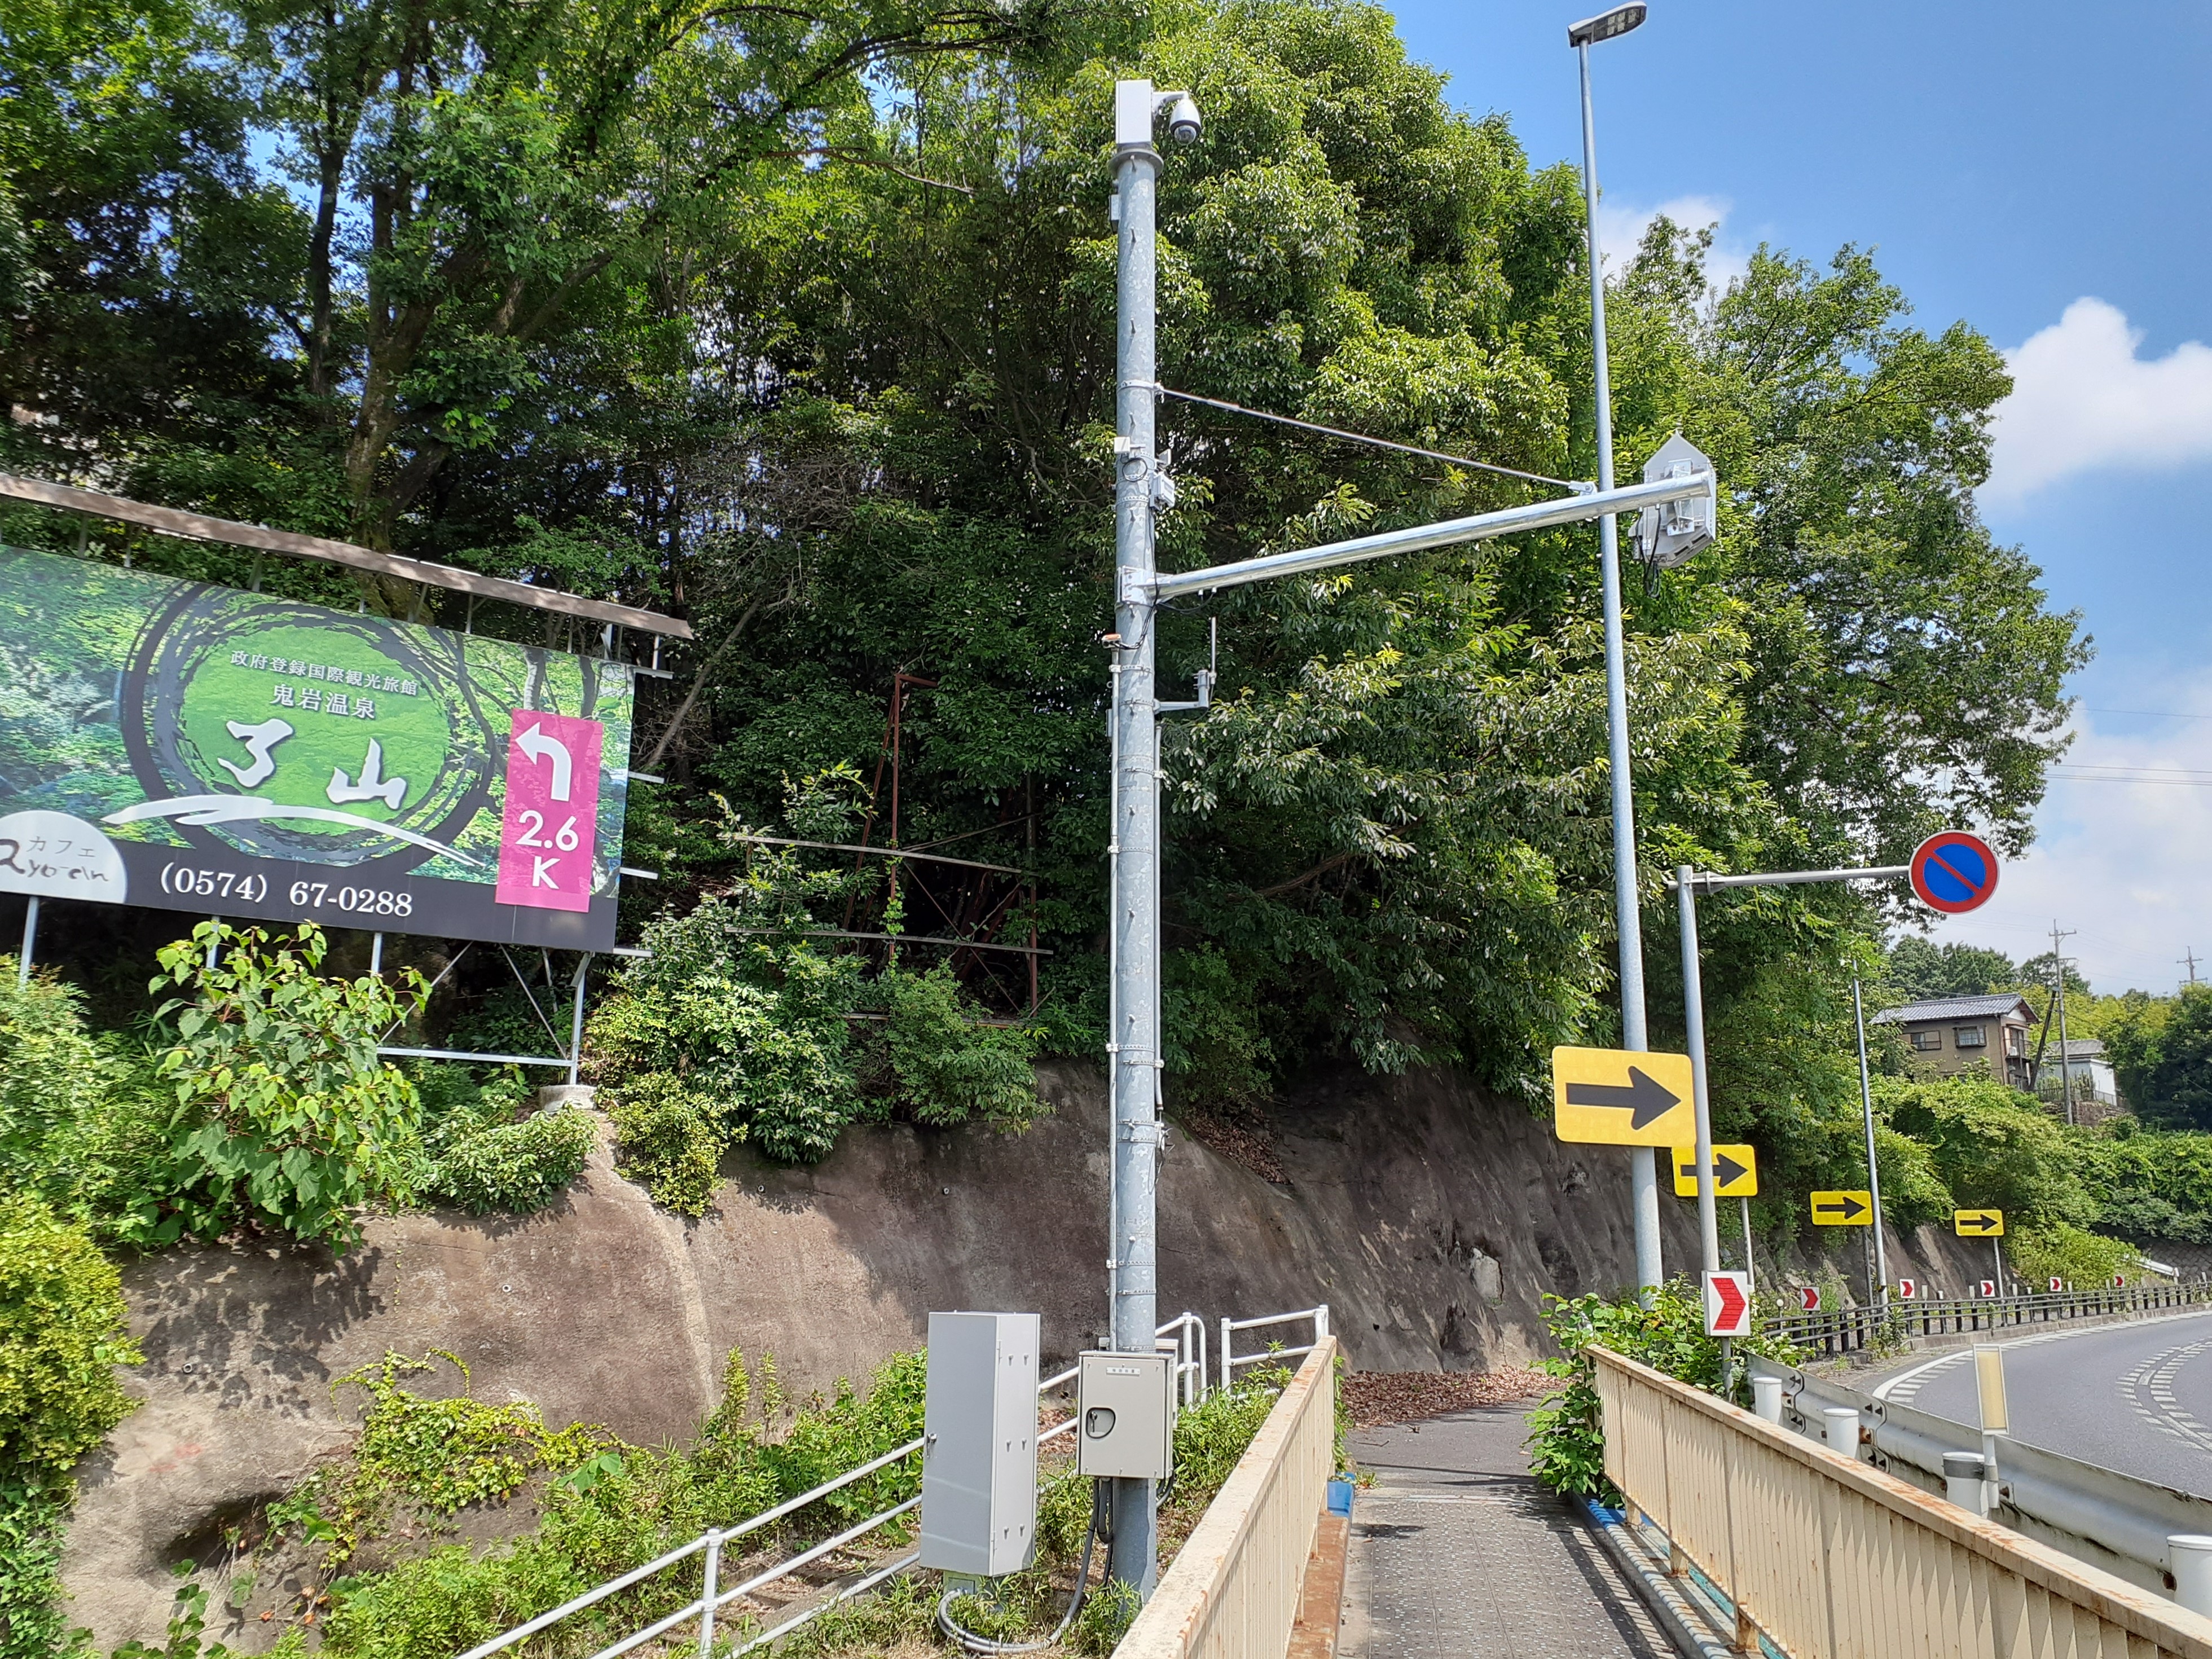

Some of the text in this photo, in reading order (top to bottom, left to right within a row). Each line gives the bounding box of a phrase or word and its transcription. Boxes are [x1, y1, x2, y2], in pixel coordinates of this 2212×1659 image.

[230, 649, 419, 696] 政府登録国際観光旅館
[269, 683, 376, 720] 鬼岩温泉
[26, 836, 96, 857] カフェ
[515, 810, 579, 852] 2.6
[160, 862, 413, 917] (0574) 67-0288
[532, 855, 561, 890] K
